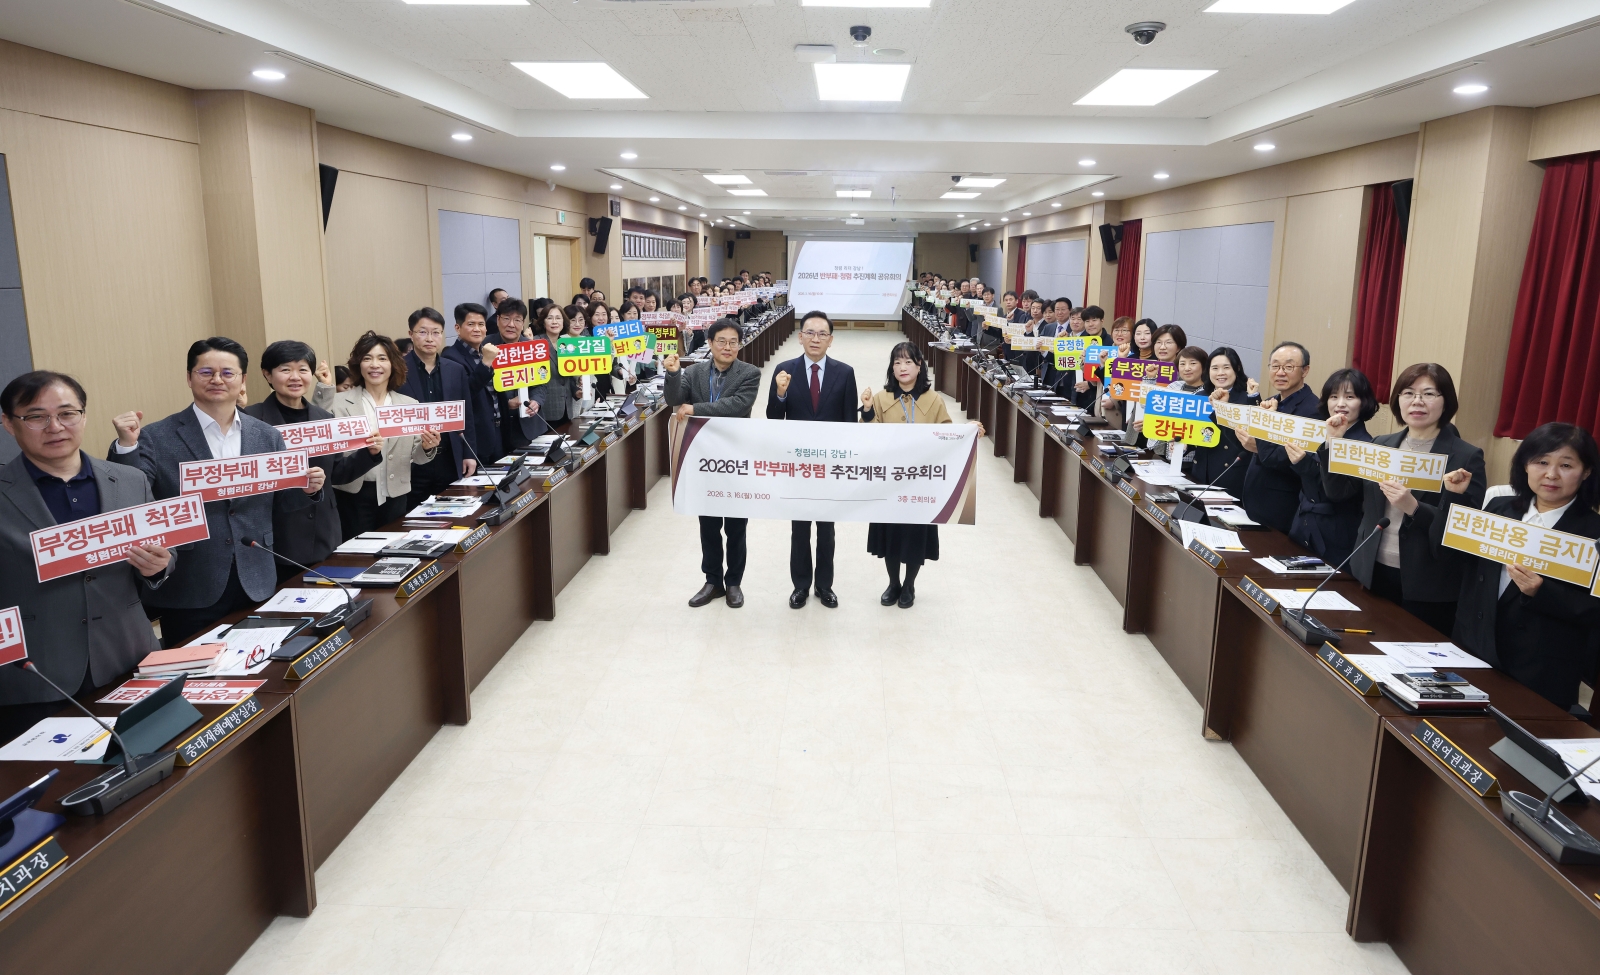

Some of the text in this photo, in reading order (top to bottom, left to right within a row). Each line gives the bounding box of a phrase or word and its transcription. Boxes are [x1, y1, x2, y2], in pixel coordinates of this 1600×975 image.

[853, 272, 876, 280] 추진계획
[496, 342, 547, 366] 권한남용
[577, 338, 606, 354] 갑질
[614, 340, 630, 354] 남!
[656, 342, 666, 352] 결!
[1056, 339, 1085, 352] 공정한
[563, 357, 607, 373] OUT!
[1115, 360, 1176, 381] 부정탁
[500, 366, 535, 388] 금지!
[378, 404, 462, 424] 부정부패 척결!
[1251, 410, 1296, 435] 권한남용
[1302, 421, 1328, 440] 금지
[281, 419, 369, 445] 정부패 척결!
[1154, 418, 1194, 440] 강남!
[303, 443, 330, 455] 렴리더
[794, 448, 827, 458] 청렴리더
[1332, 442, 1442, 475] 권한남용 금지!
[184, 454, 305, 487] 부정부패 척결!
[698, 457, 947, 481] 2026년 반부패·청렴 추진계획 공유회의
[217, 481, 278, 497] 청렴리더 강남!
[706, 490, 725, 498] 2026.
[38, 500, 200, 557] 부정부패 척결!
[1452, 510, 1594, 564] 권한남용 금지!
[85, 545, 133, 564] 청렴리더
[1479, 543, 1549, 570] 청렴리더 강남!
[1244, 582, 1271, 607] 세곡동장
[303, 635, 343, 670] 감사담당관
[1326, 651, 1363, 685] 재무과장
[181, 689, 248, 701] 부정부
[184, 699, 257, 758] 중대재해예방실장
[1422, 729, 1483, 784] 민원여권과장
